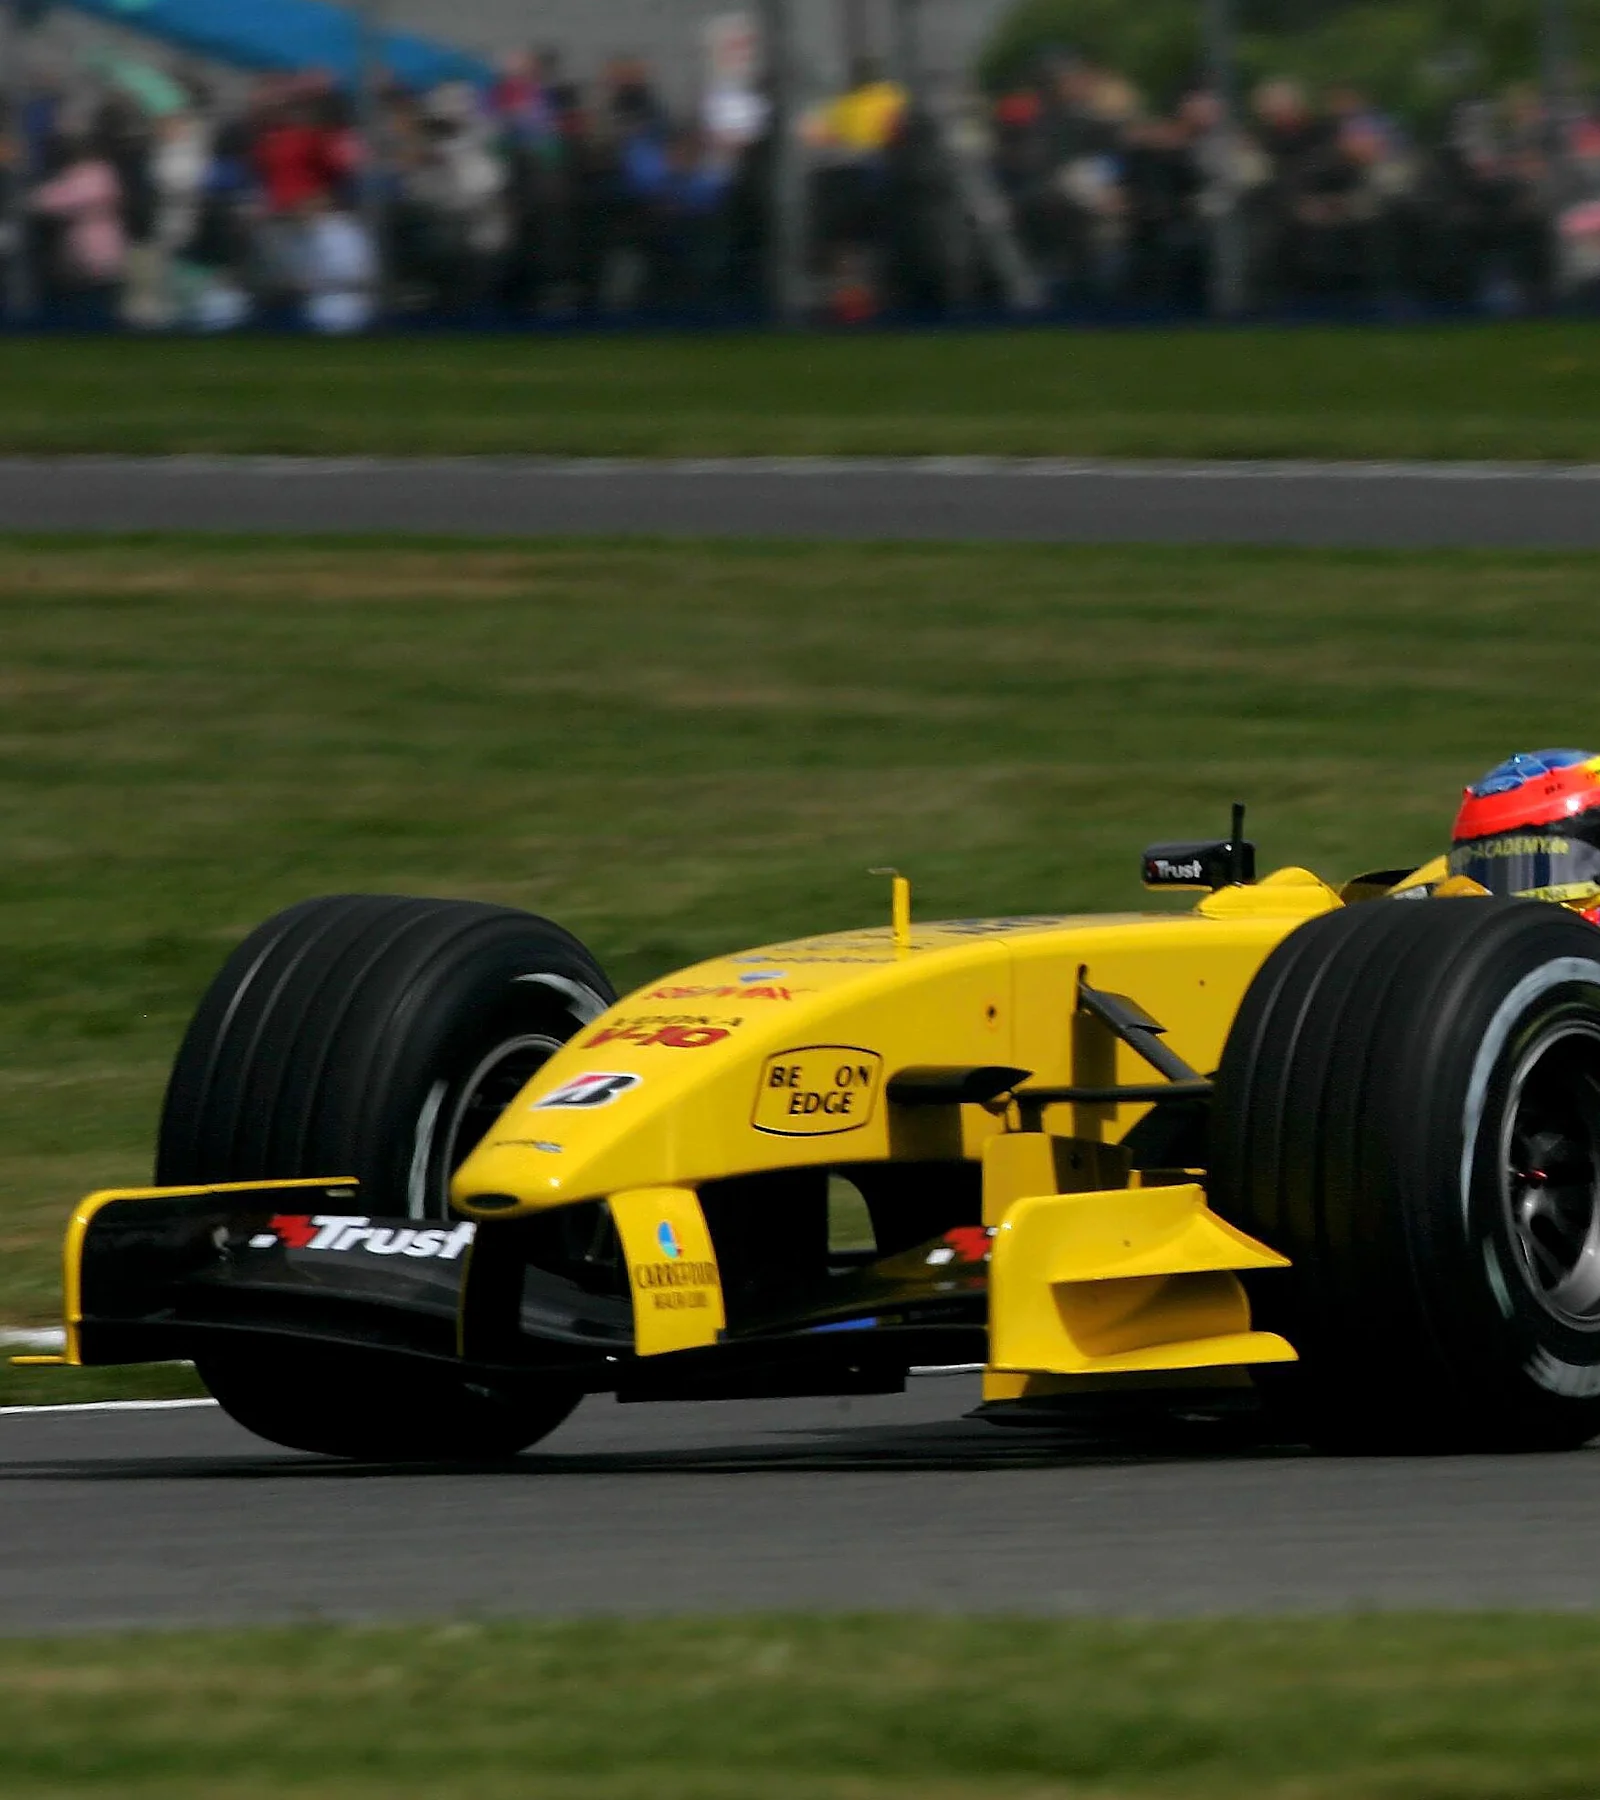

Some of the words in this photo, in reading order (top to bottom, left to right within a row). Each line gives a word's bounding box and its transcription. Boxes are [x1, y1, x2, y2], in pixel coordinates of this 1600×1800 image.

[1153, 859, 1203, 879] Trust
[770, 1065, 803, 1088] BE
[788, 1091, 855, 1115] EDGE
[306, 1214, 477, 1259] Trust
